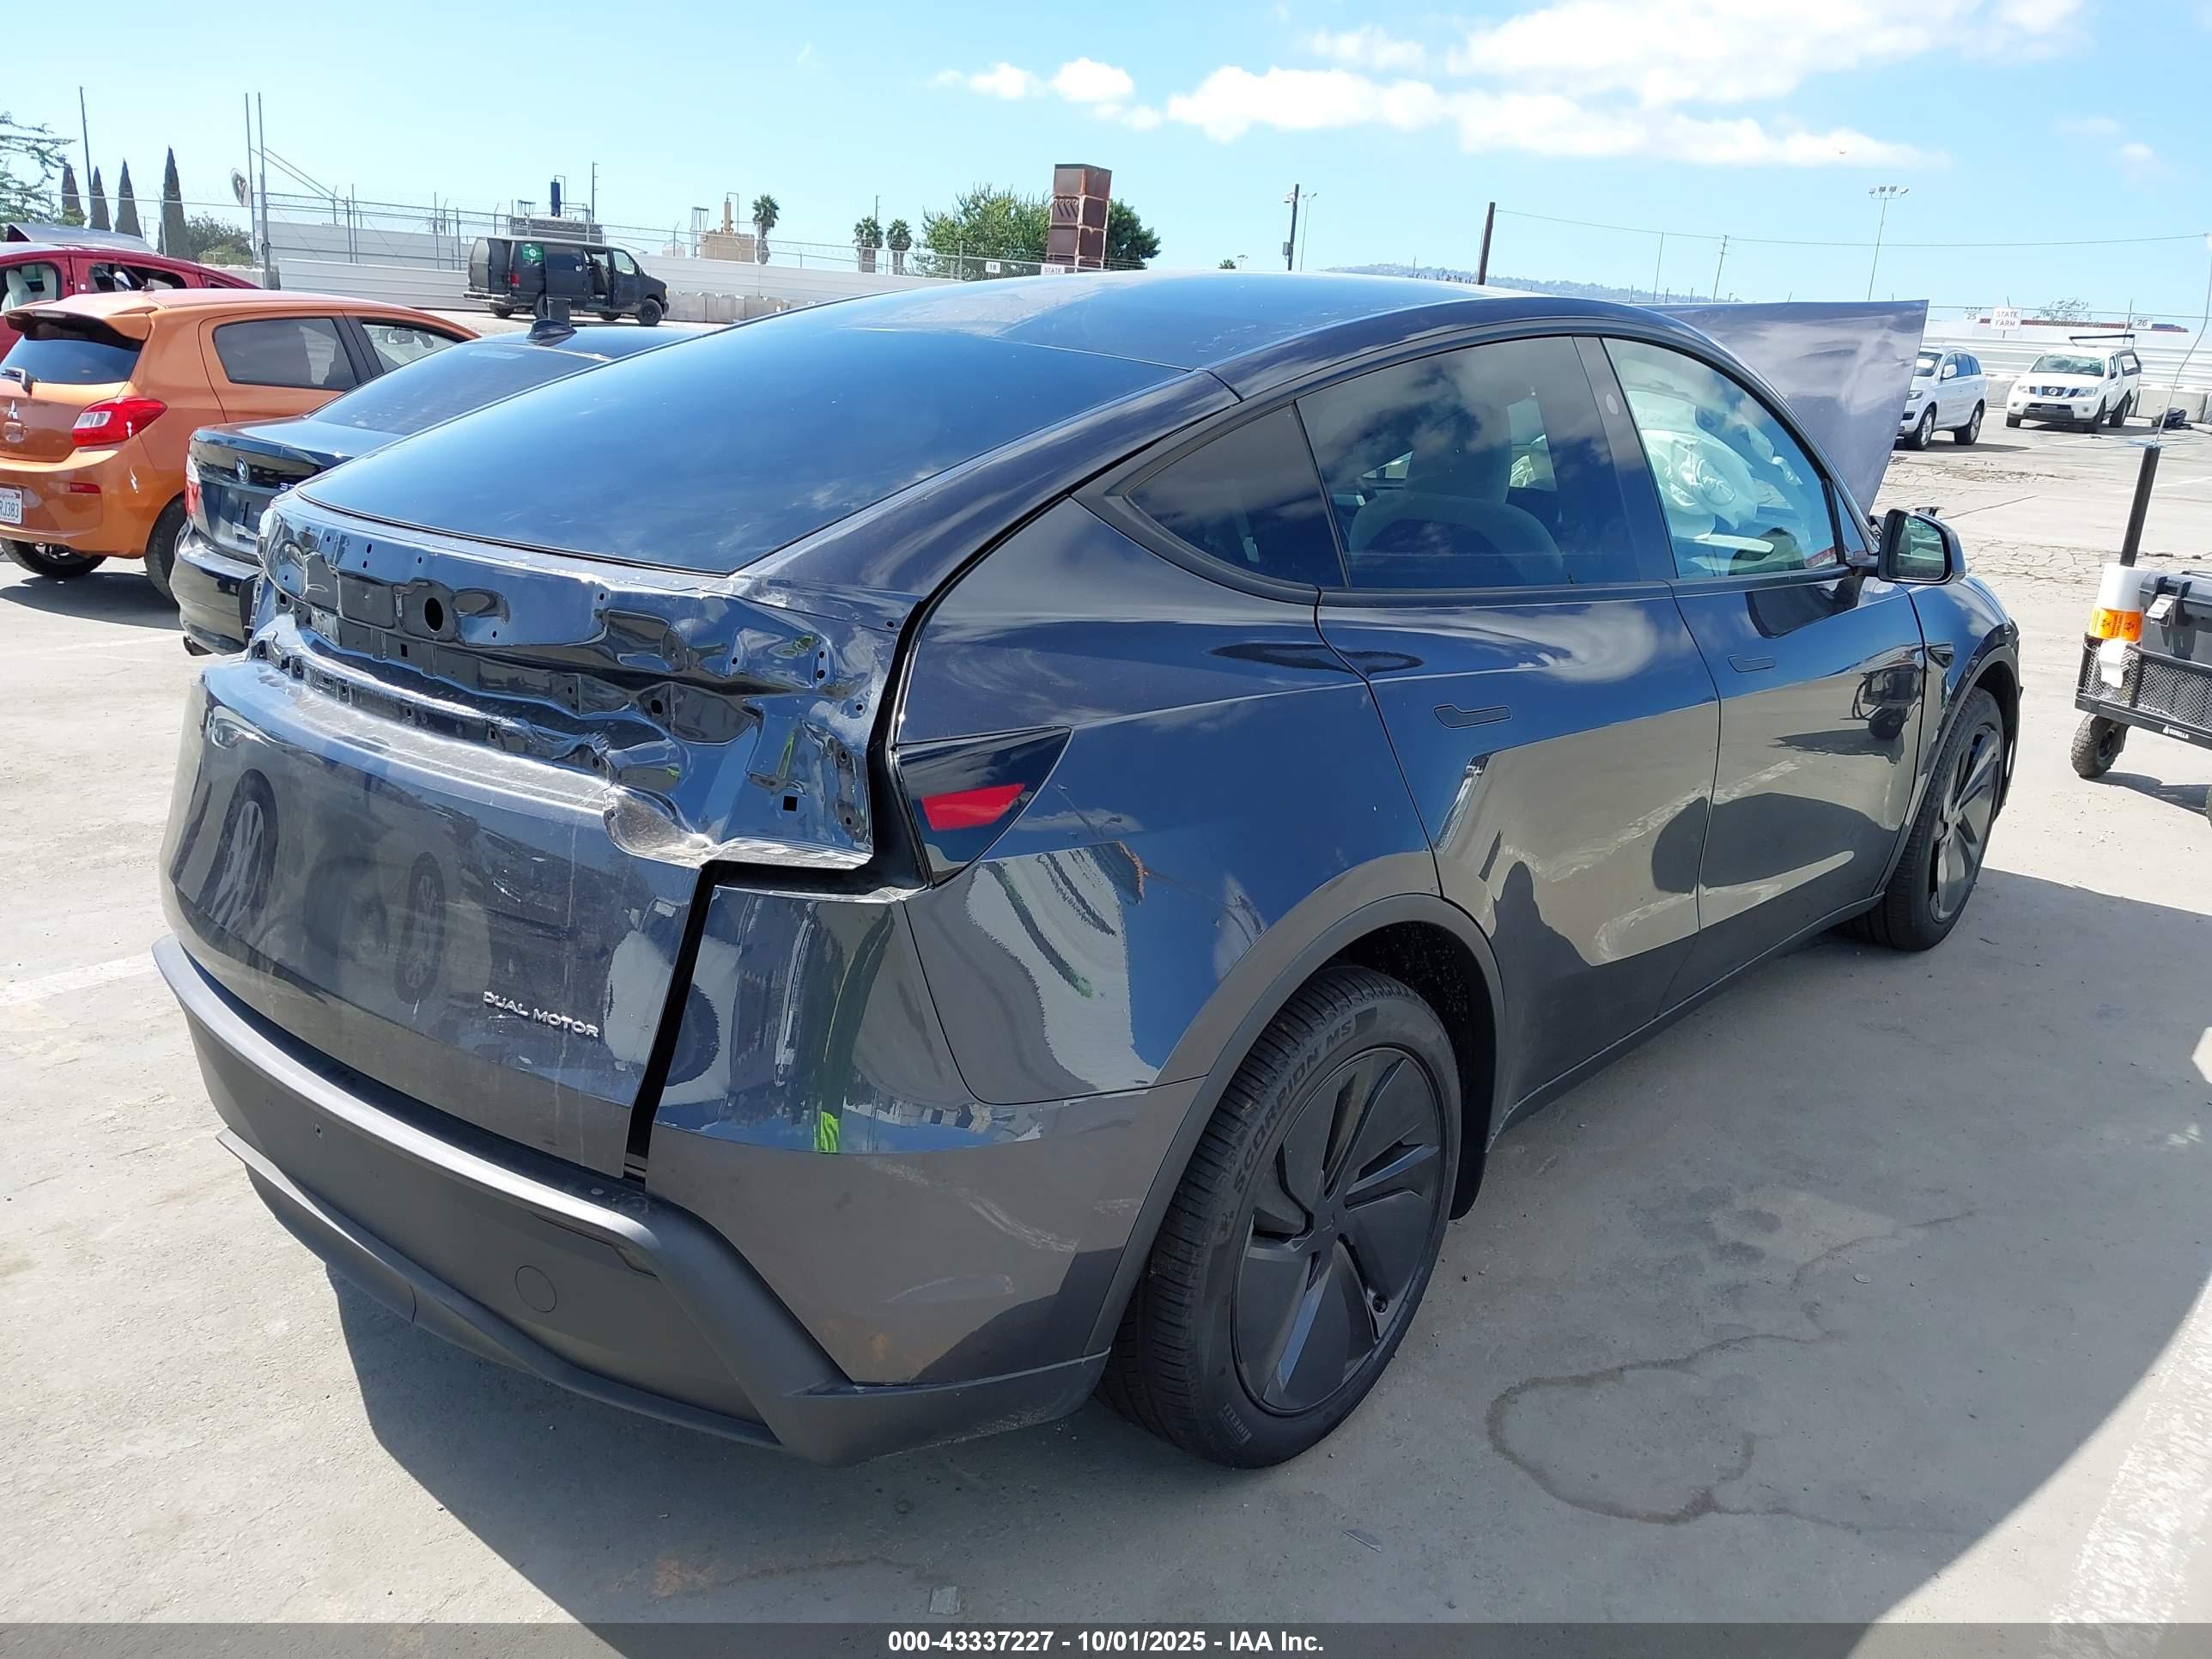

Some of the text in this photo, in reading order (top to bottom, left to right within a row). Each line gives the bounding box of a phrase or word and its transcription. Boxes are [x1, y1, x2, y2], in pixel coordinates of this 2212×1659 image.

[1996, 310, 2019, 319] STATE
[483, 990, 599, 1038] DUAL MOTOR
[1234, 1019, 1352, 1194] SCORPION MS
